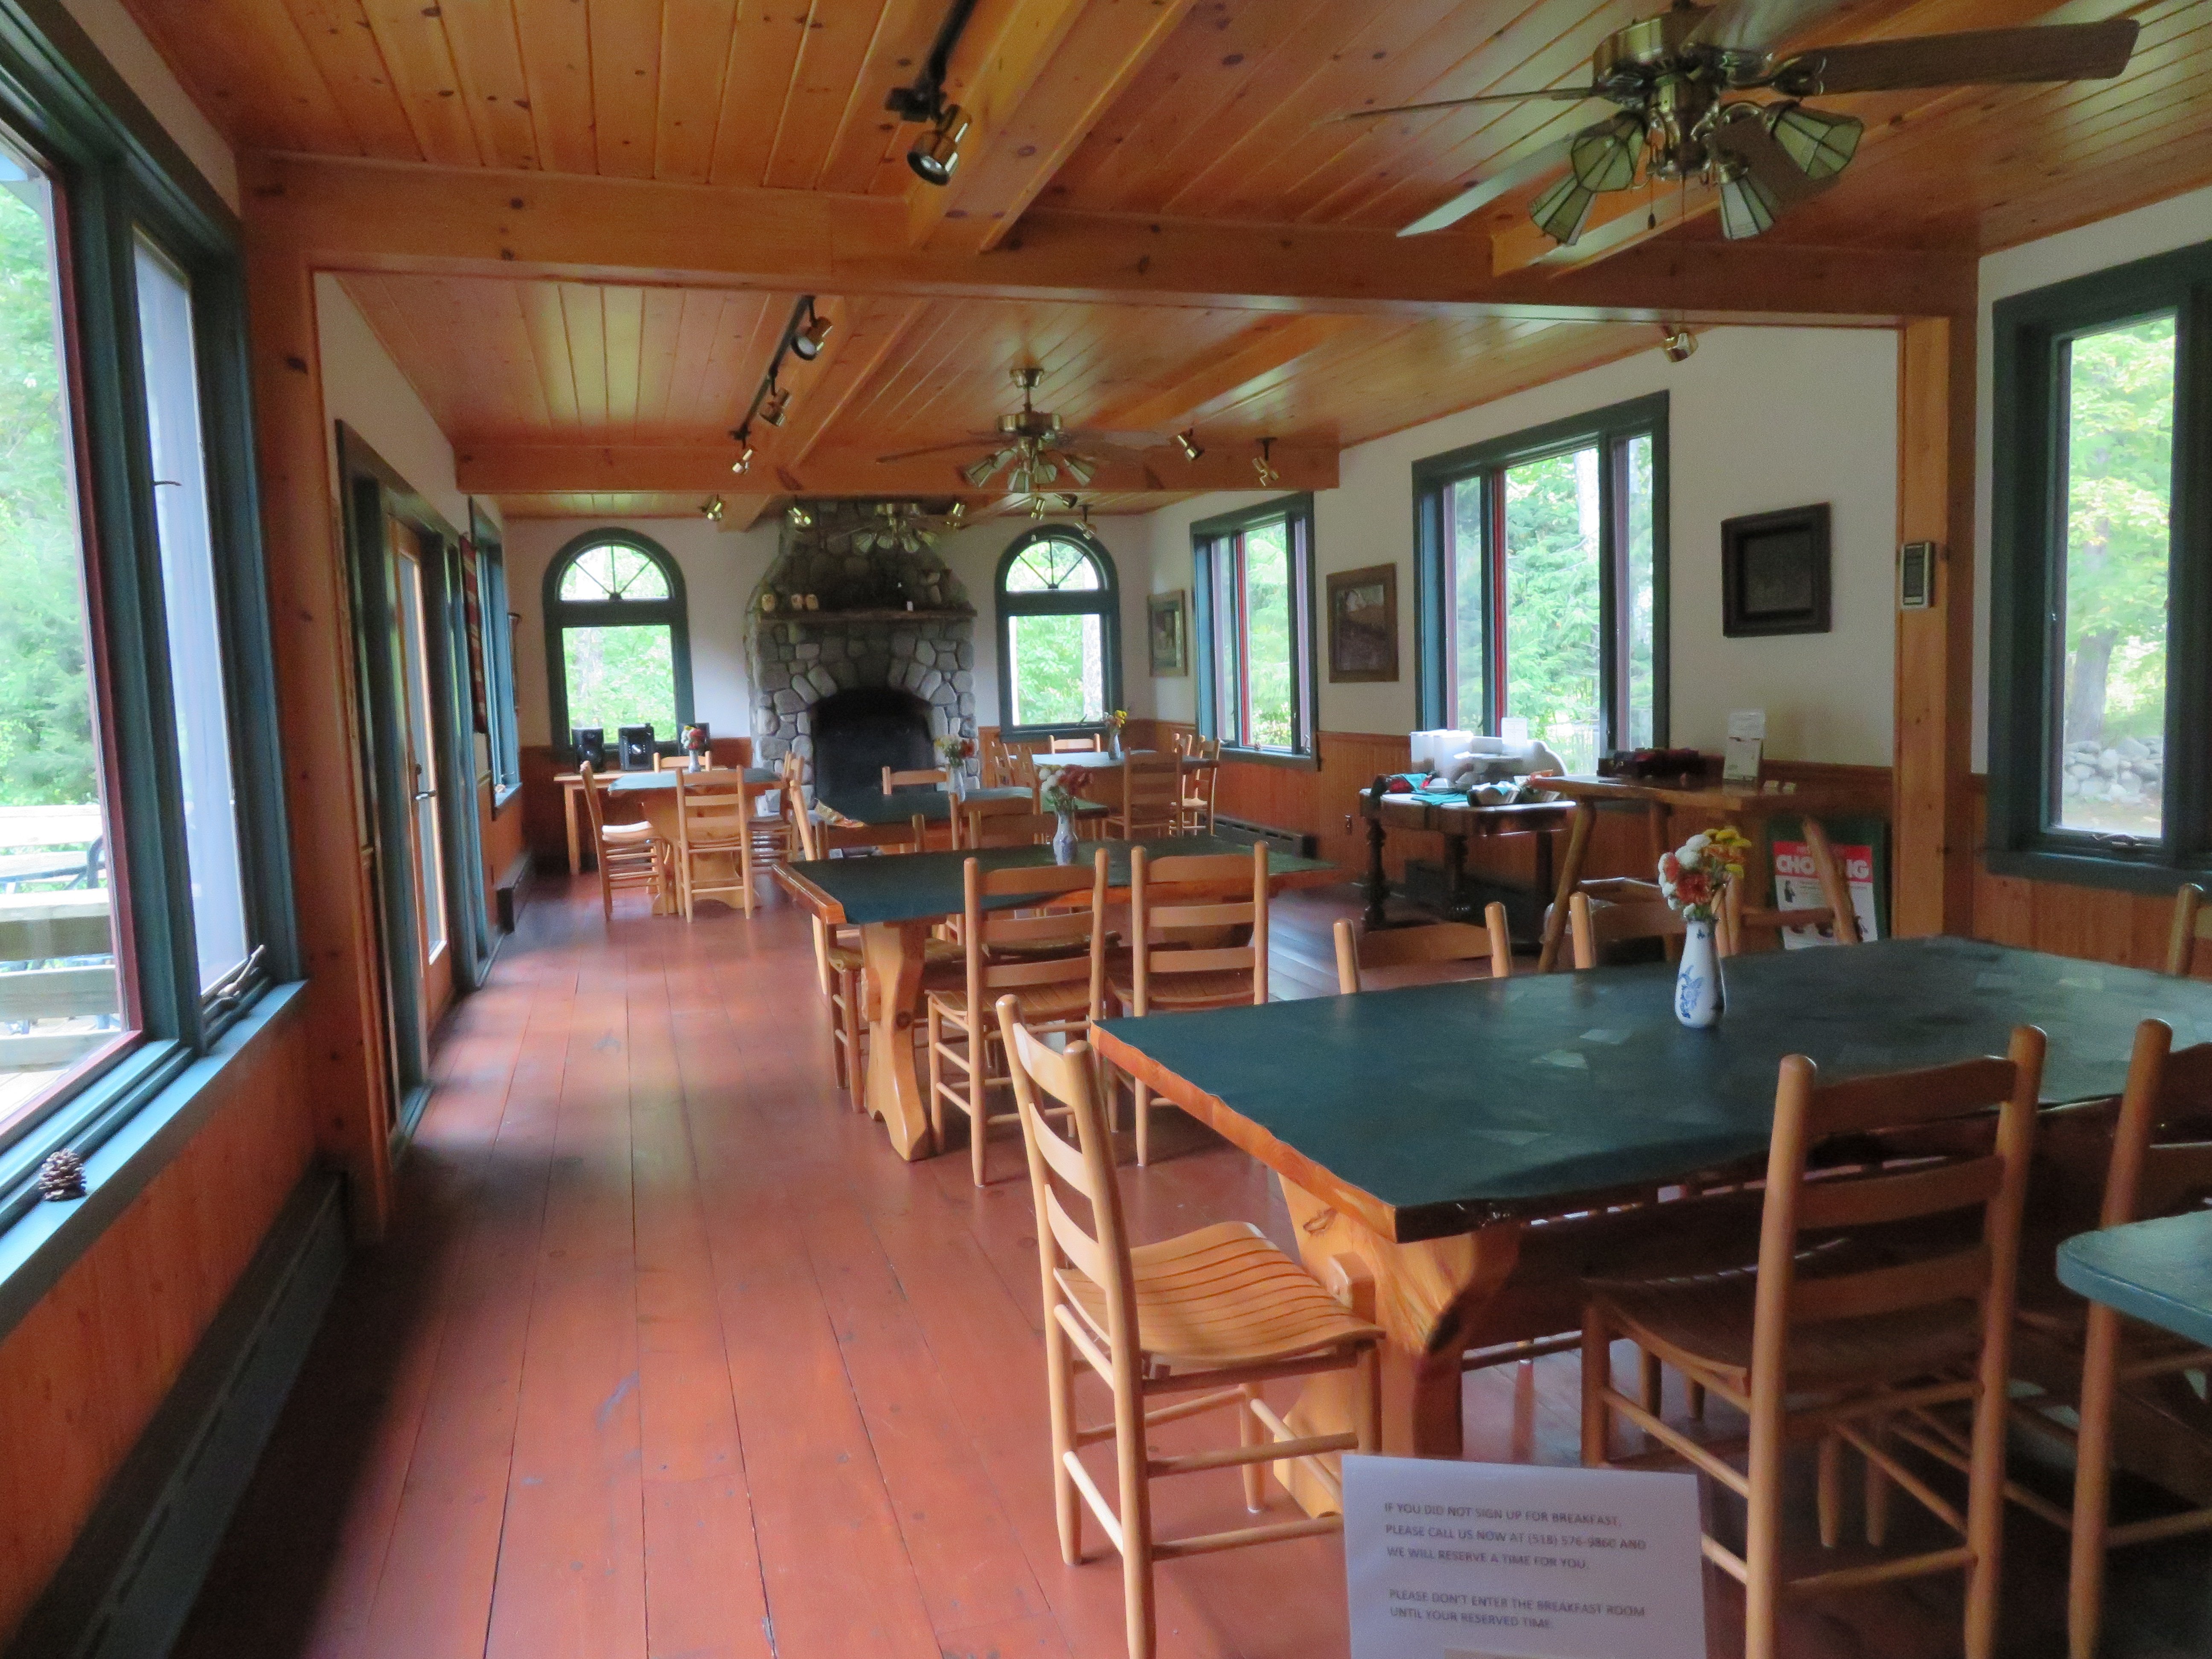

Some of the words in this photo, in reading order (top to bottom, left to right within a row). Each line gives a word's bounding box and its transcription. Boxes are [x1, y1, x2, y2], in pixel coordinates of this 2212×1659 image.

[1384, 1503, 1393, 1512] IF
[1397, 1504, 1421, 1514] YOU
[1424, 1505, 1444, 1515] DID
[1447, 1506, 1472, 1516] NOT
[1476, 1508, 1502, 1519] SIGN
[1506, 1510, 1521, 1520] UP
[1525, 1511, 1548, 1521] FOR
[1385, 1524, 1425, 1536] PLEASE
[1428, 1527, 1454, 1538] CALL
[1458, 1529, 1473, 1540] US
[1476, 1530, 1506, 1541] NOW
[1509, 1532, 1525, 1542] AT
[1528, 1533, 1557, 1546] (518)
[1619, 1539, 1647, 1550] AND
[1387, 1547, 1404, 1557] WE
[1408, 1548, 1435, 1559] WILL
[1438, 1550, 1486, 1562] RESERVE
[1490, 1554, 1499, 1563] A
[1502, 1554, 1531, 1565] TIME
[1534, 1556, 1557, 1566] FOR
[1389, 1589, 1429, 1601] PLEASE
[1432, 1592, 1467, 1604] DON'T
[1471, 1595, 1508, 1608] ENTER
[1511, 1598, 1533, 1610] THE
[1537, 1600, 1602, 1614] BREAKFAST
[1606, 1604, 1644, 1616] ROOM
[1391, 1607, 1422, 1619] UNTIL
[1426, 1610, 1457, 1621] YOUR
[1461, 1612, 1518, 1626] RESERVED
